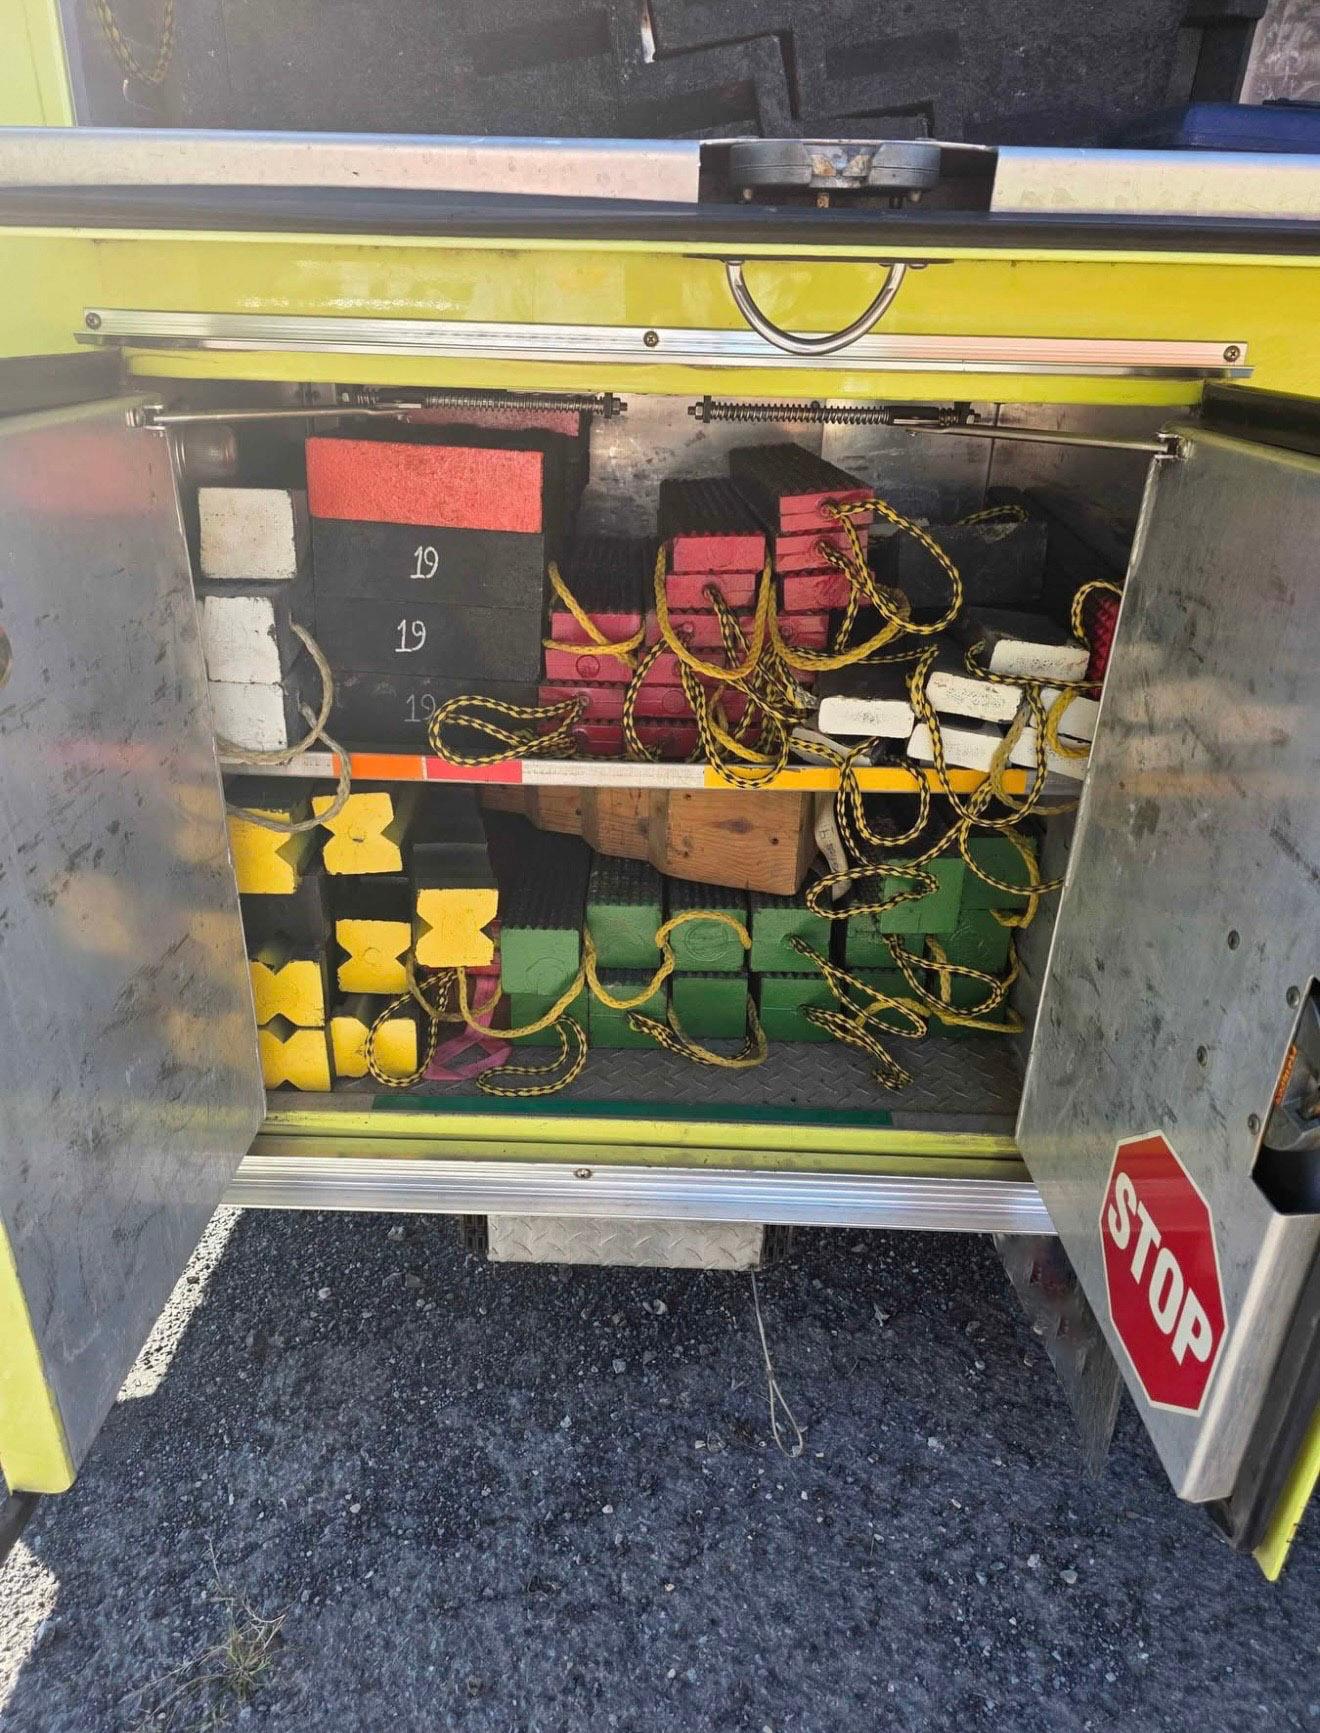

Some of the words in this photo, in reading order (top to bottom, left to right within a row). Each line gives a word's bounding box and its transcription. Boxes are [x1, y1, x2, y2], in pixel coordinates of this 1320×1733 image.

[409, 545, 439, 579] 19
[395, 619, 426, 653] 19
[403, 693, 436, 722] 19
[1107, 1171, 1213, 1366] STOP
